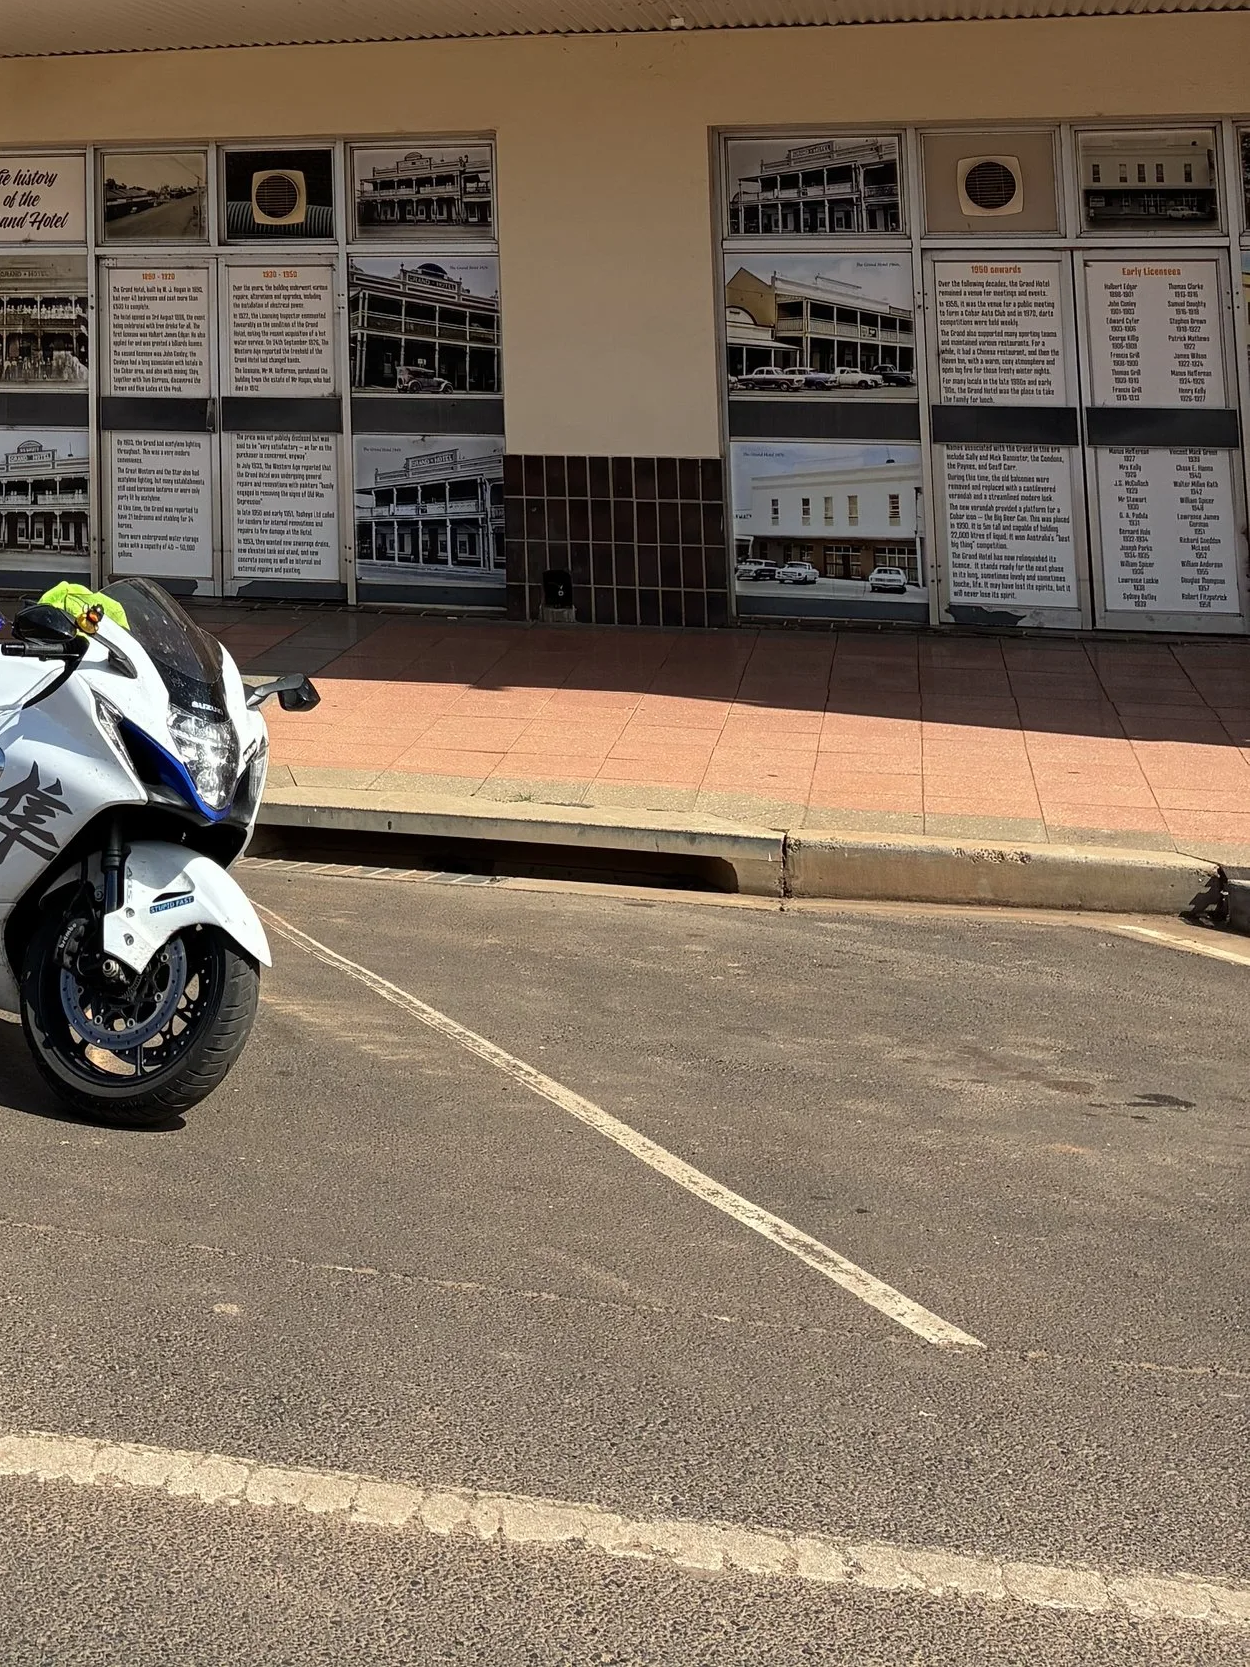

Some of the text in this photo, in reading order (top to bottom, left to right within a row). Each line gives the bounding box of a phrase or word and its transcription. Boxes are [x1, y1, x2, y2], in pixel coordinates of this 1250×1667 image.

[13, 169, 57, 187] history
[3, 191, 40, 208] of the
[29, 212, 69, 230] Hotel
[990, 266, 1021, 274] onwards
[1122, 267, 1181, 277] Early Licensees
